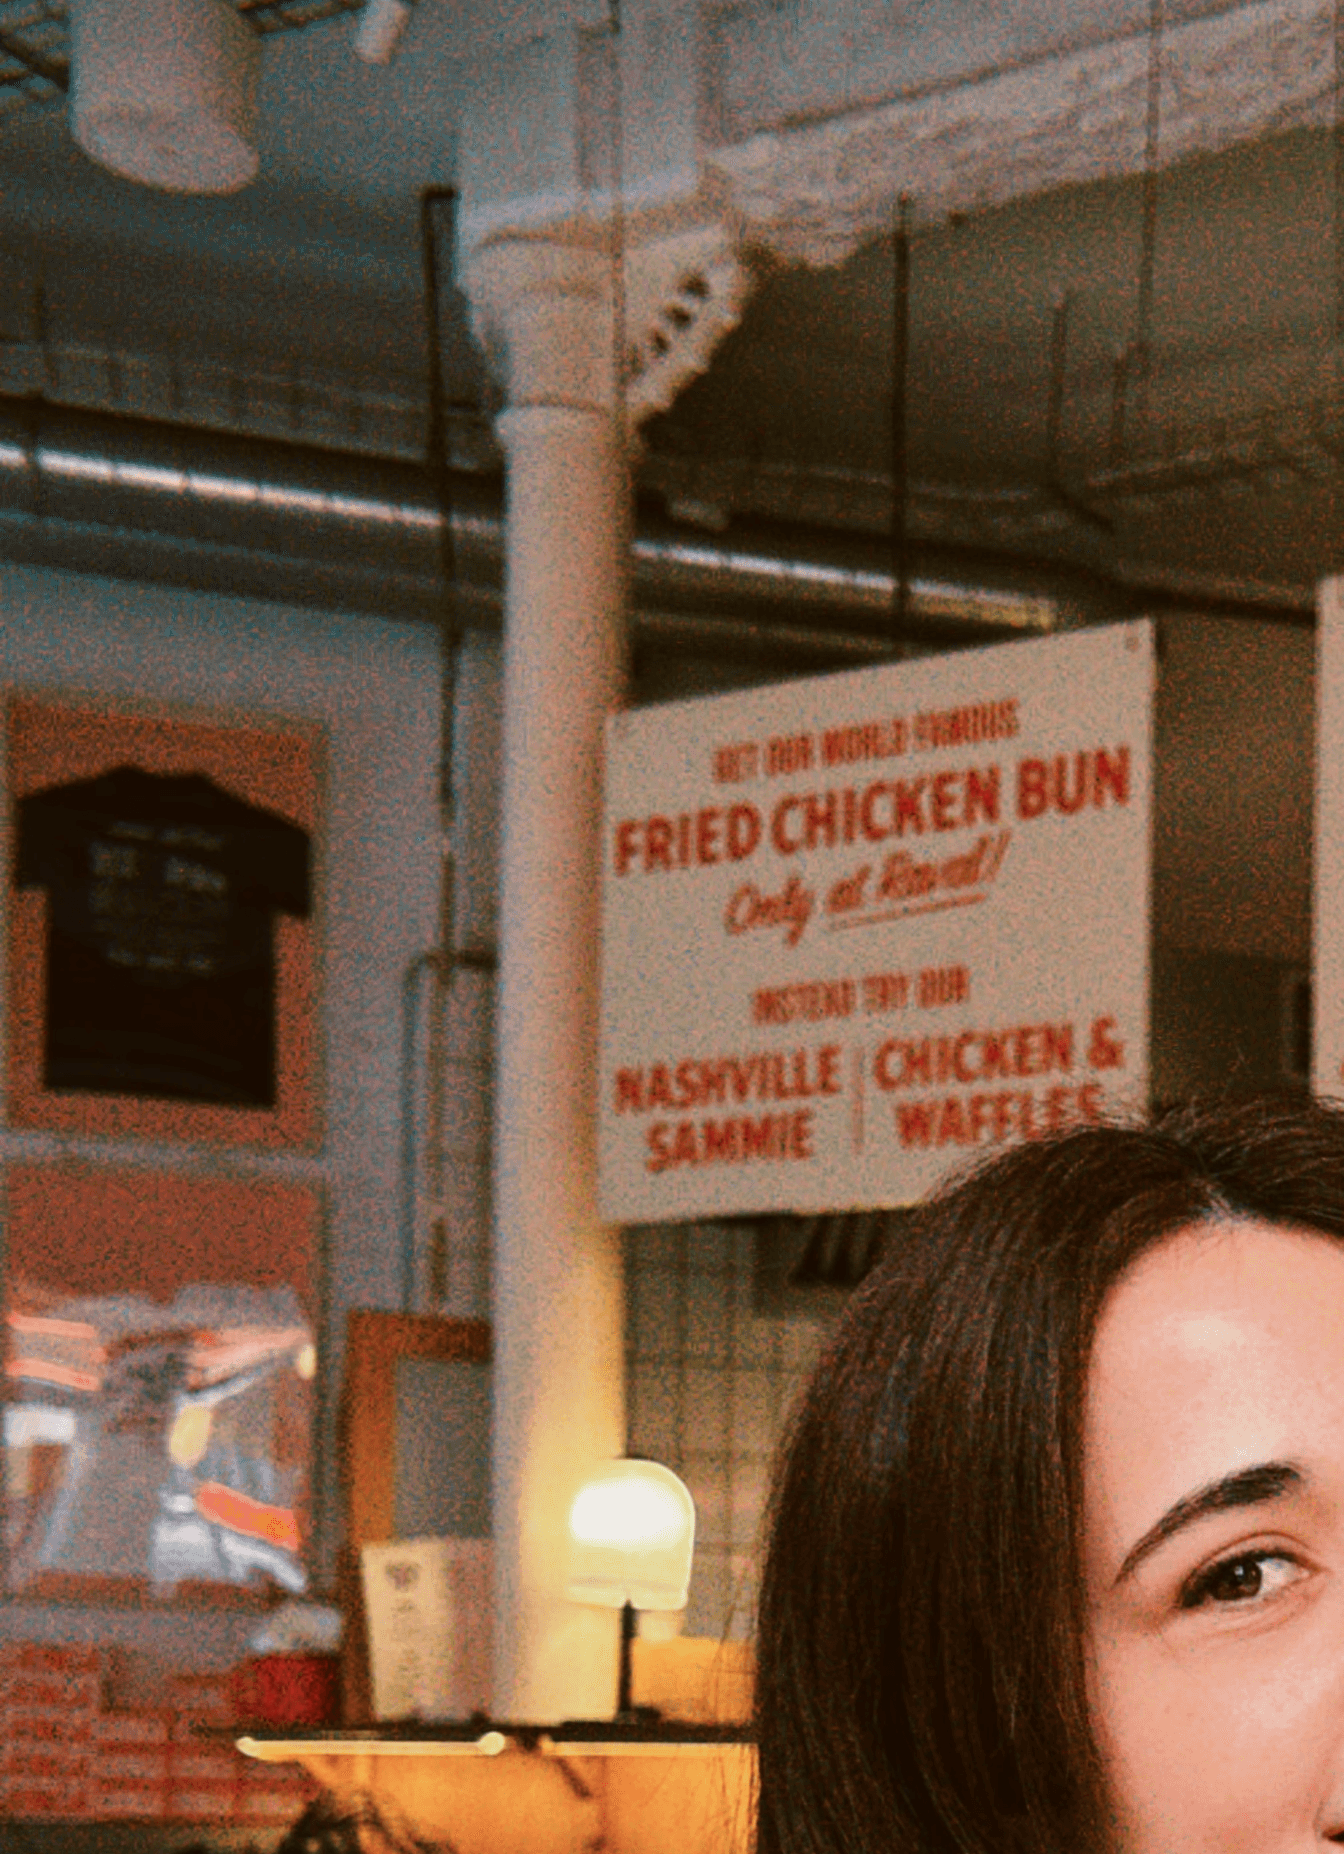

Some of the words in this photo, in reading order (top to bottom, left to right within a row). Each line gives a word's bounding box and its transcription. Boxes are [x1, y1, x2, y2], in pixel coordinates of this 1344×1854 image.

[613, 802, 762, 877] FRIED
[770, 763, 1001, 857] CHICKEN
[1015, 743, 1132, 821] BUN
[723, 876, 816, 948] Only
[612, 1042, 842, 1117] NASHVILLE
[873, 1022, 1075, 1093] CHICKEN
[1087, 1014, 1127, 1072] &
[645, 1106, 816, 1174] SAMMIE
